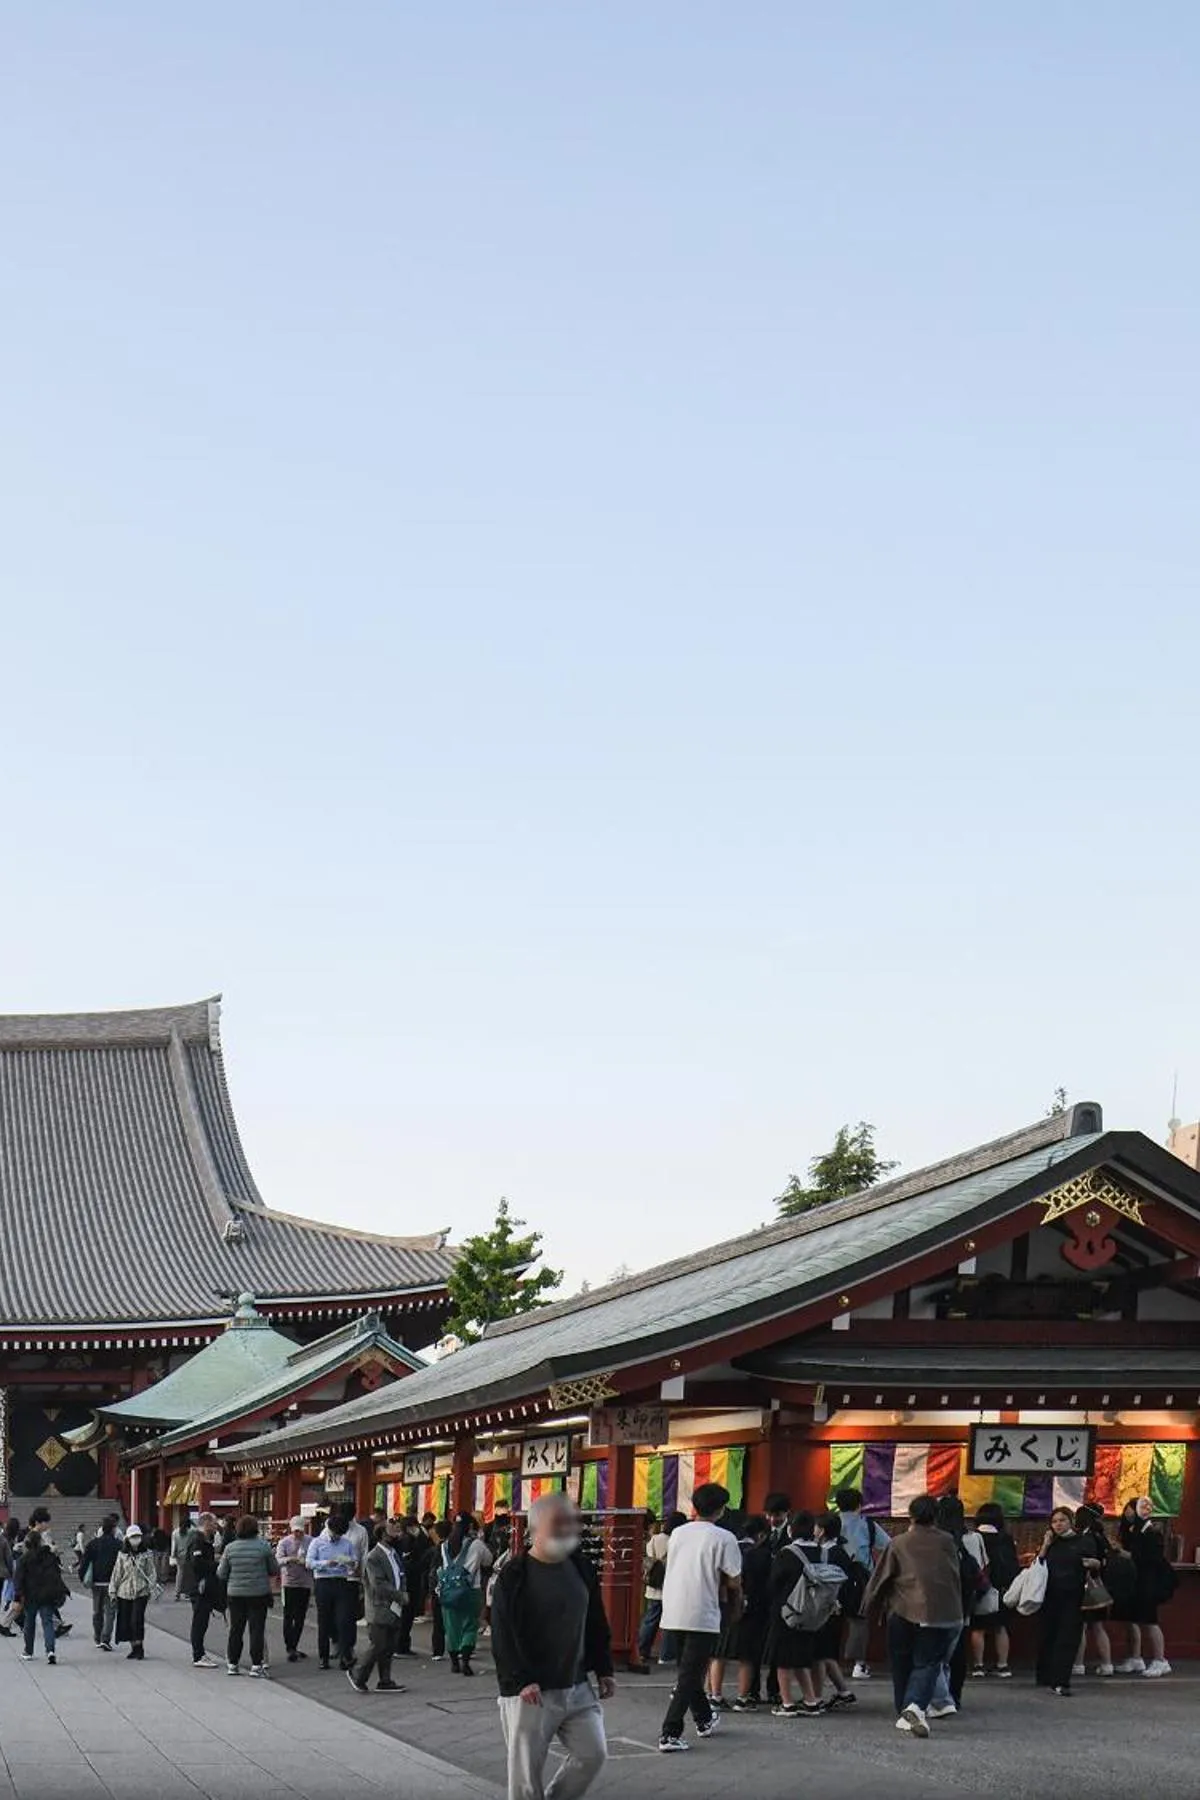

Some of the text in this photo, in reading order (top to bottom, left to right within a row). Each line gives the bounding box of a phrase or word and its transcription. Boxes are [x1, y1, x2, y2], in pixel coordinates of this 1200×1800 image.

[527, 1439, 566, 1469] みくじ
[983, 1433, 1080, 1463] みくじ
